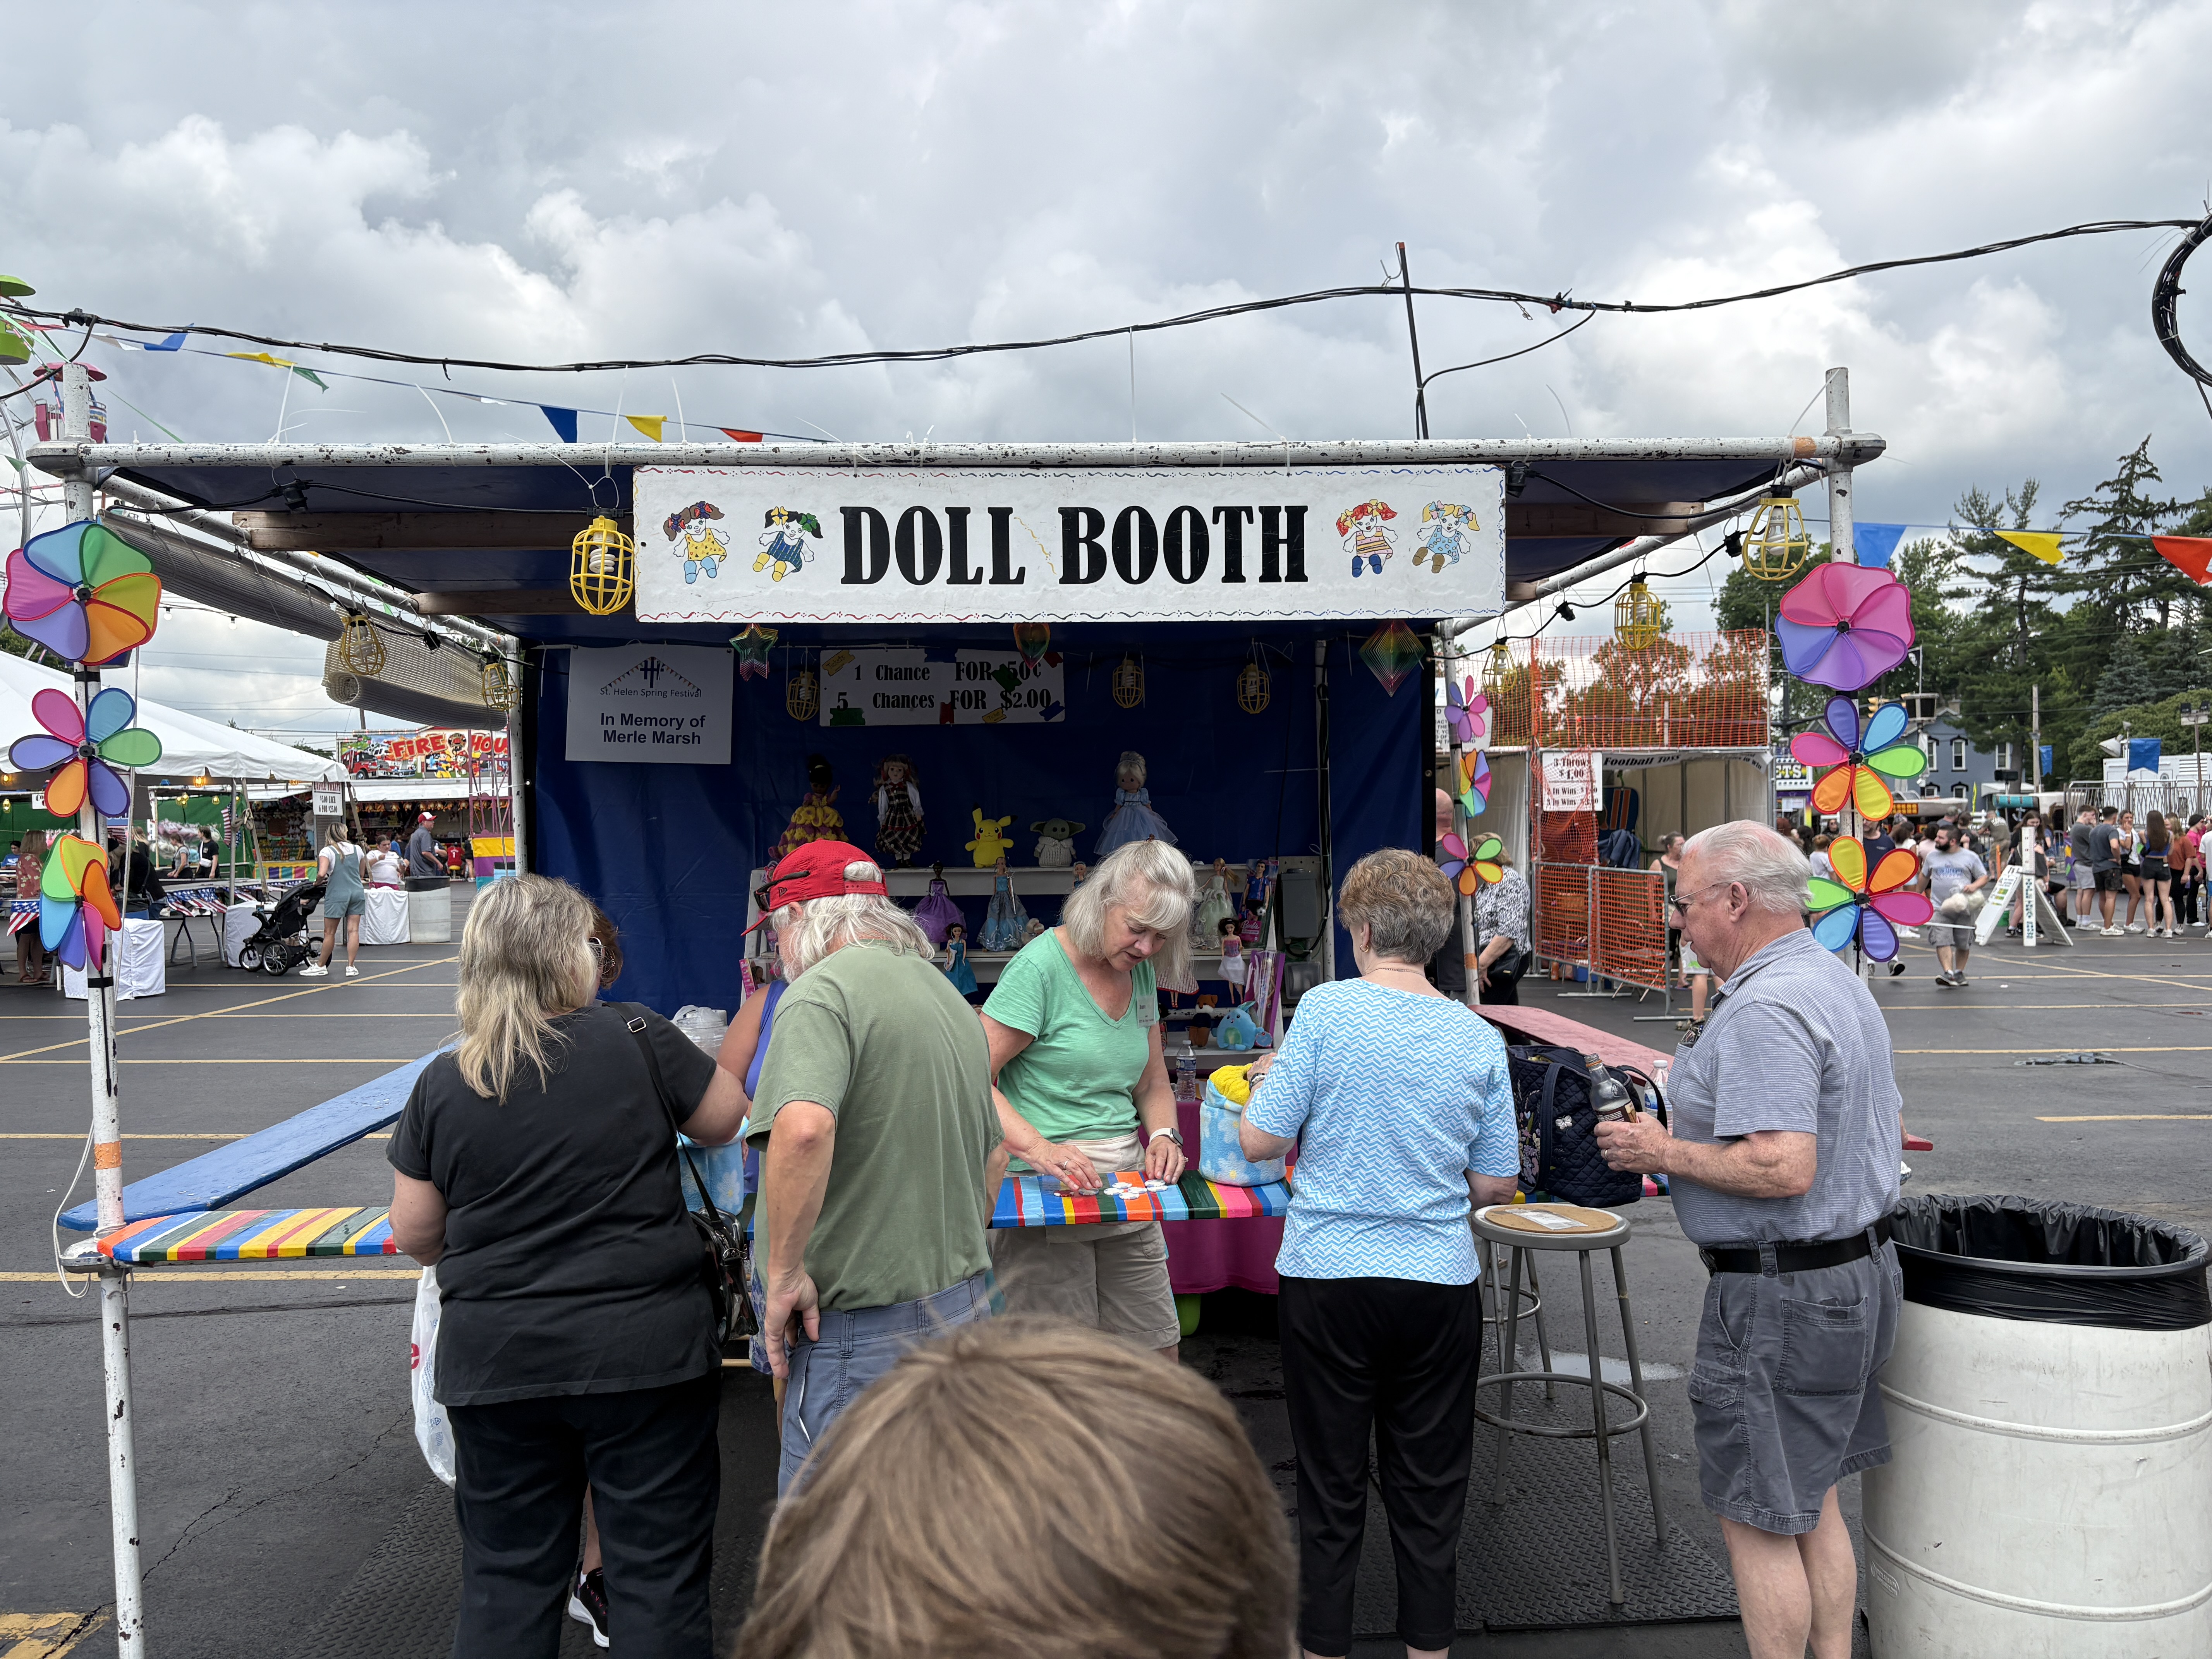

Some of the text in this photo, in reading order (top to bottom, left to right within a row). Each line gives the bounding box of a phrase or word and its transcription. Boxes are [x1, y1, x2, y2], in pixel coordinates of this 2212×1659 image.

[839, 505, 1309, 585] DOLL BOOTH
[855, 665, 861, 680] 1
[875, 665, 930, 680] Chance
[955, 661, 992, 681] FOR
[641, 689, 667, 698] Spring
[670, 689, 702, 697] Festival
[837, 689, 1051, 711] 5 Chances FOR $2.00
[601, 713, 706, 730] In Memory of
[603, 730, 701, 744] Merle Marsh
[1603, 757, 1654, 766] Football
